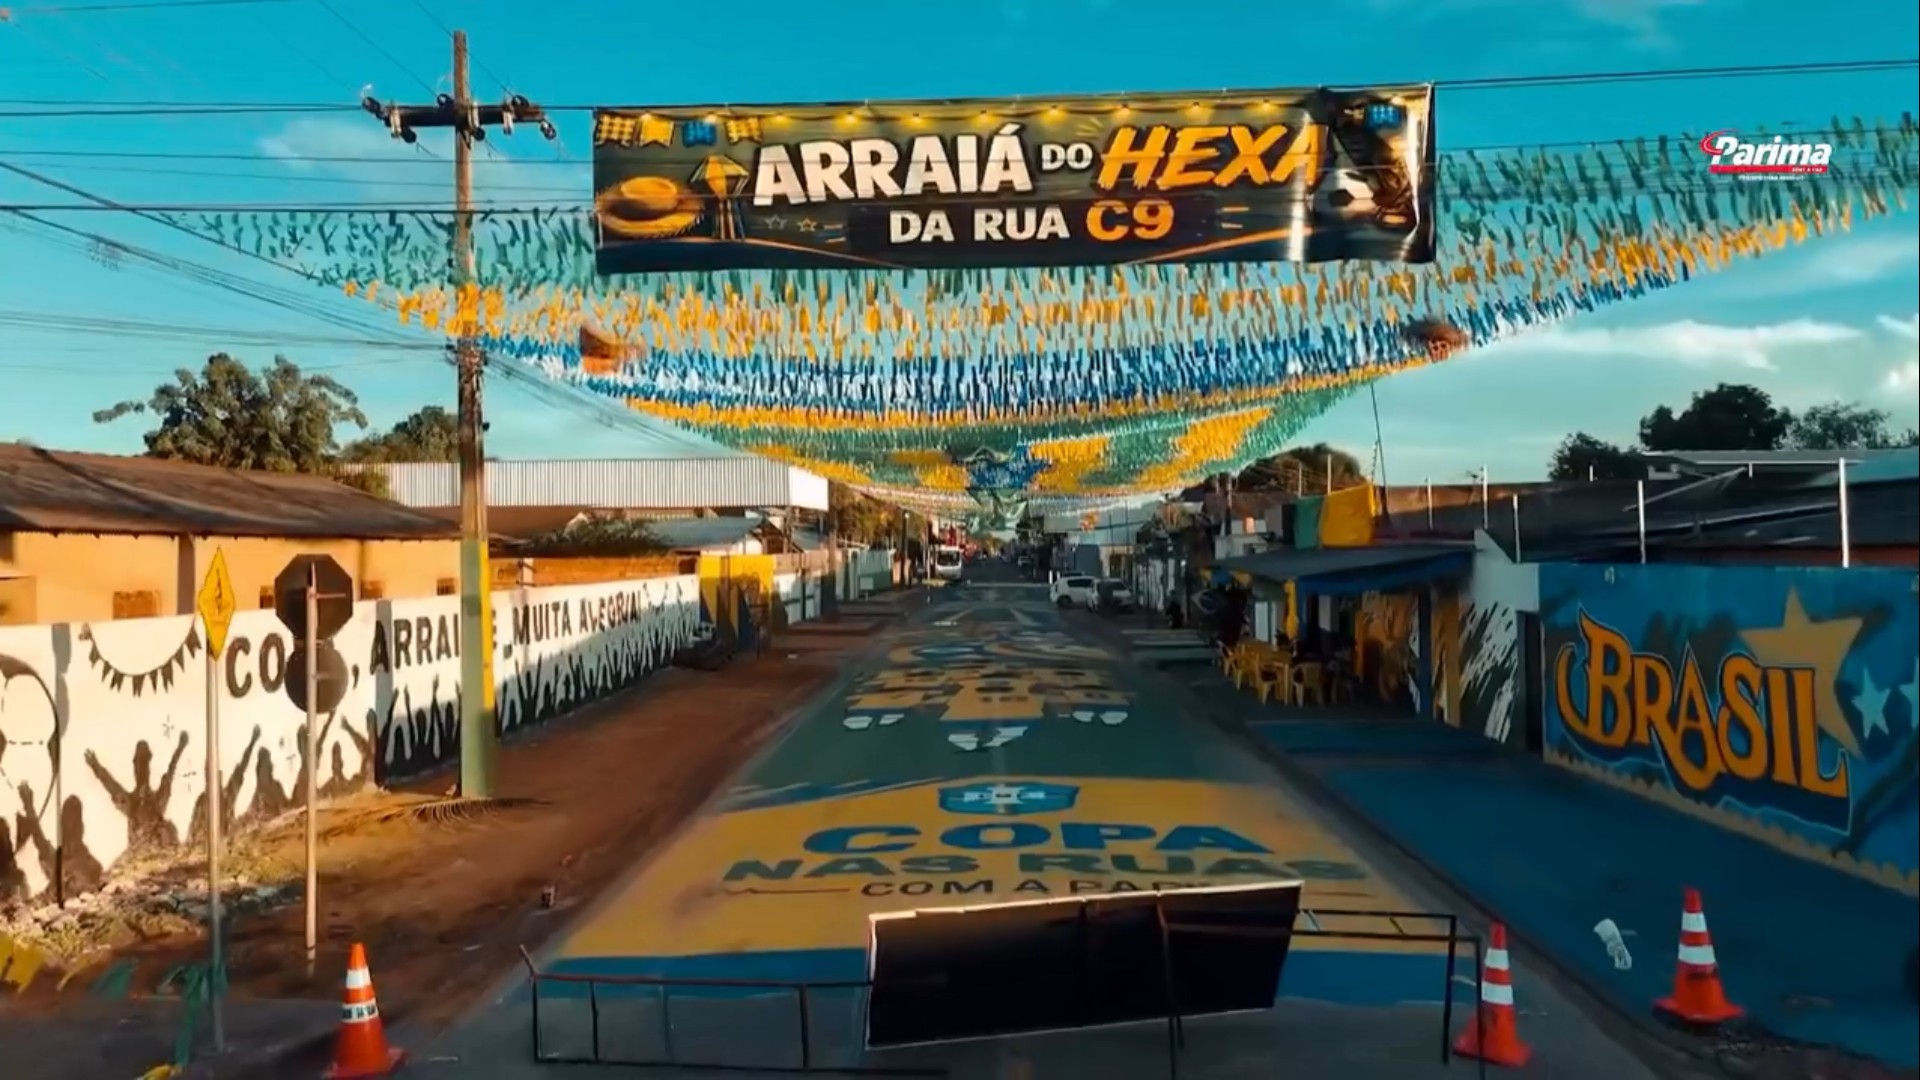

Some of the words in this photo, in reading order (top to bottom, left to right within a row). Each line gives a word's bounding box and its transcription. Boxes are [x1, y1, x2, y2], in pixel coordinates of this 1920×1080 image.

[753, 123, 1033, 206] ARRAIÁ
[1041, 143, 1094, 171] DO
[1098, 125, 1328, 190] HEXA
[890, 210, 954, 243] DA
[974, 207, 1070, 241] RUA
[1085, 201, 1174, 241] C9
[369, 612, 460, 675] ARRAI
[513, 600, 571, 645] MUITA
[1556, 605, 1848, 798] BRASIL
[803, 822, 1274, 854] COPA
[723, 854, 980, 881] NAS
[1018, 852, 1368, 880] RUAS
[861, 879, 994, 897] COM
[1011, 879, 1049, 895] A
